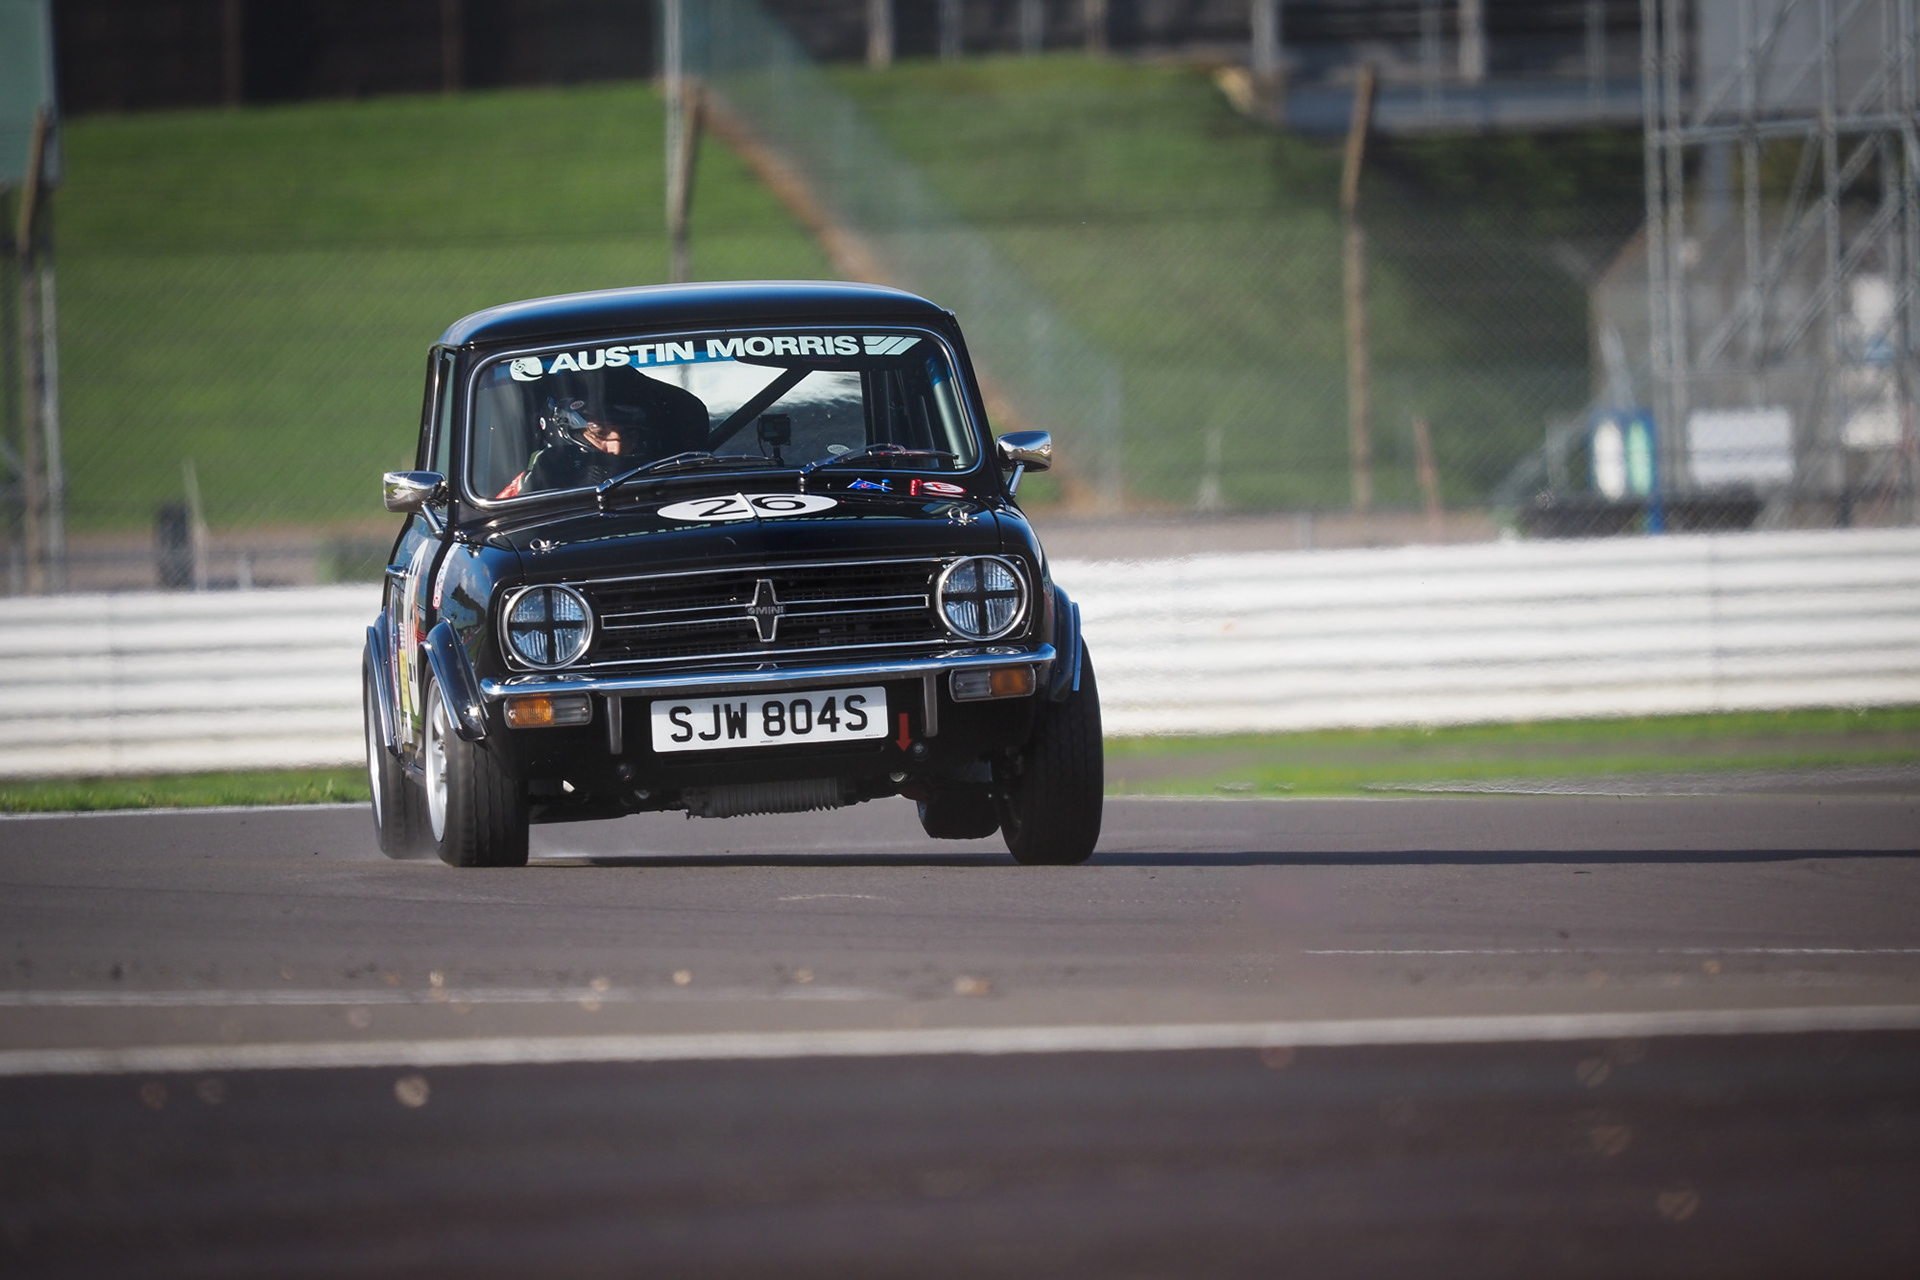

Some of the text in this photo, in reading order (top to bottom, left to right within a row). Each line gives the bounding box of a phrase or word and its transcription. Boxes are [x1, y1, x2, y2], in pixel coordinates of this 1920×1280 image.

[547, 335, 860, 374] AUSTIN MORRIS
[690, 494, 808, 518] 26
[755, 605, 785, 615] MINI
[668, 694, 868, 743] SJW 804S
